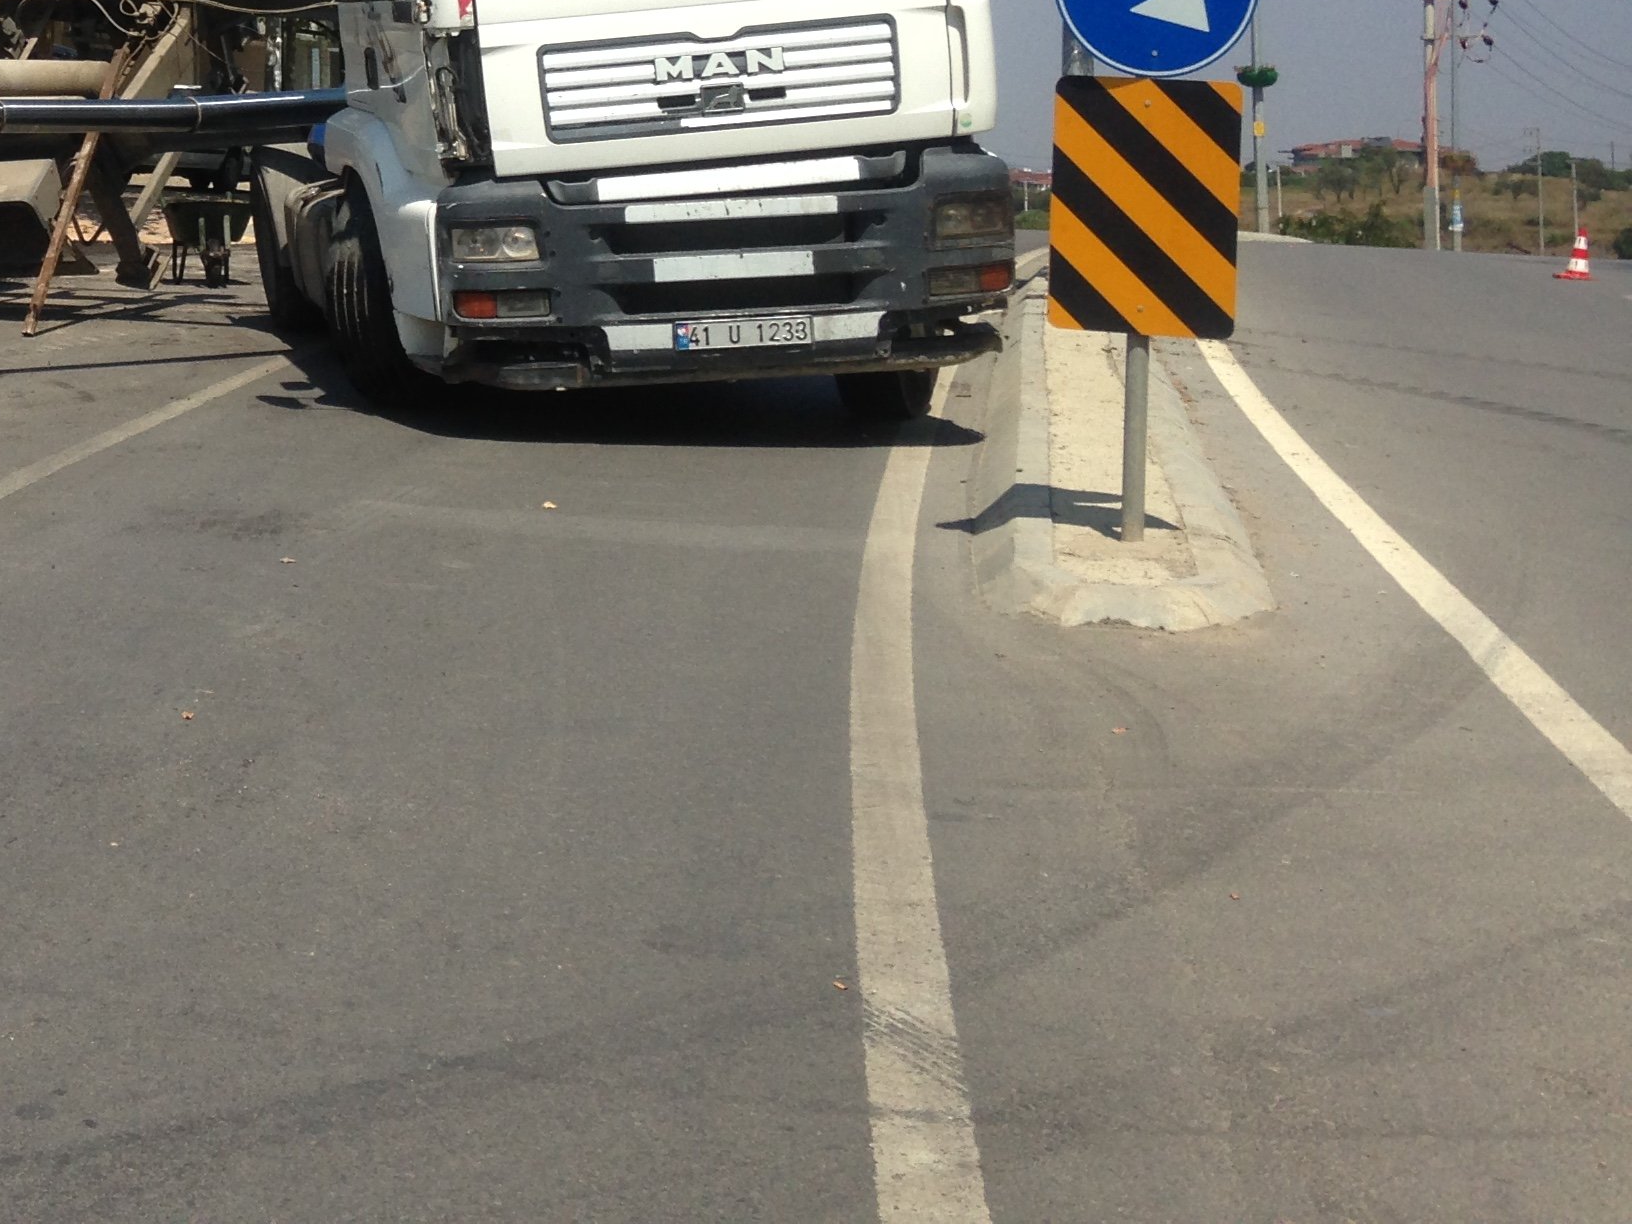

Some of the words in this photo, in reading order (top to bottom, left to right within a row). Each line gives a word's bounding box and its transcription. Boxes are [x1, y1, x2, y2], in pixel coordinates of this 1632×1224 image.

[654, 46, 785, 82] MAN
[689, 326, 710, 346] 41
[729, 325, 741, 344] U
